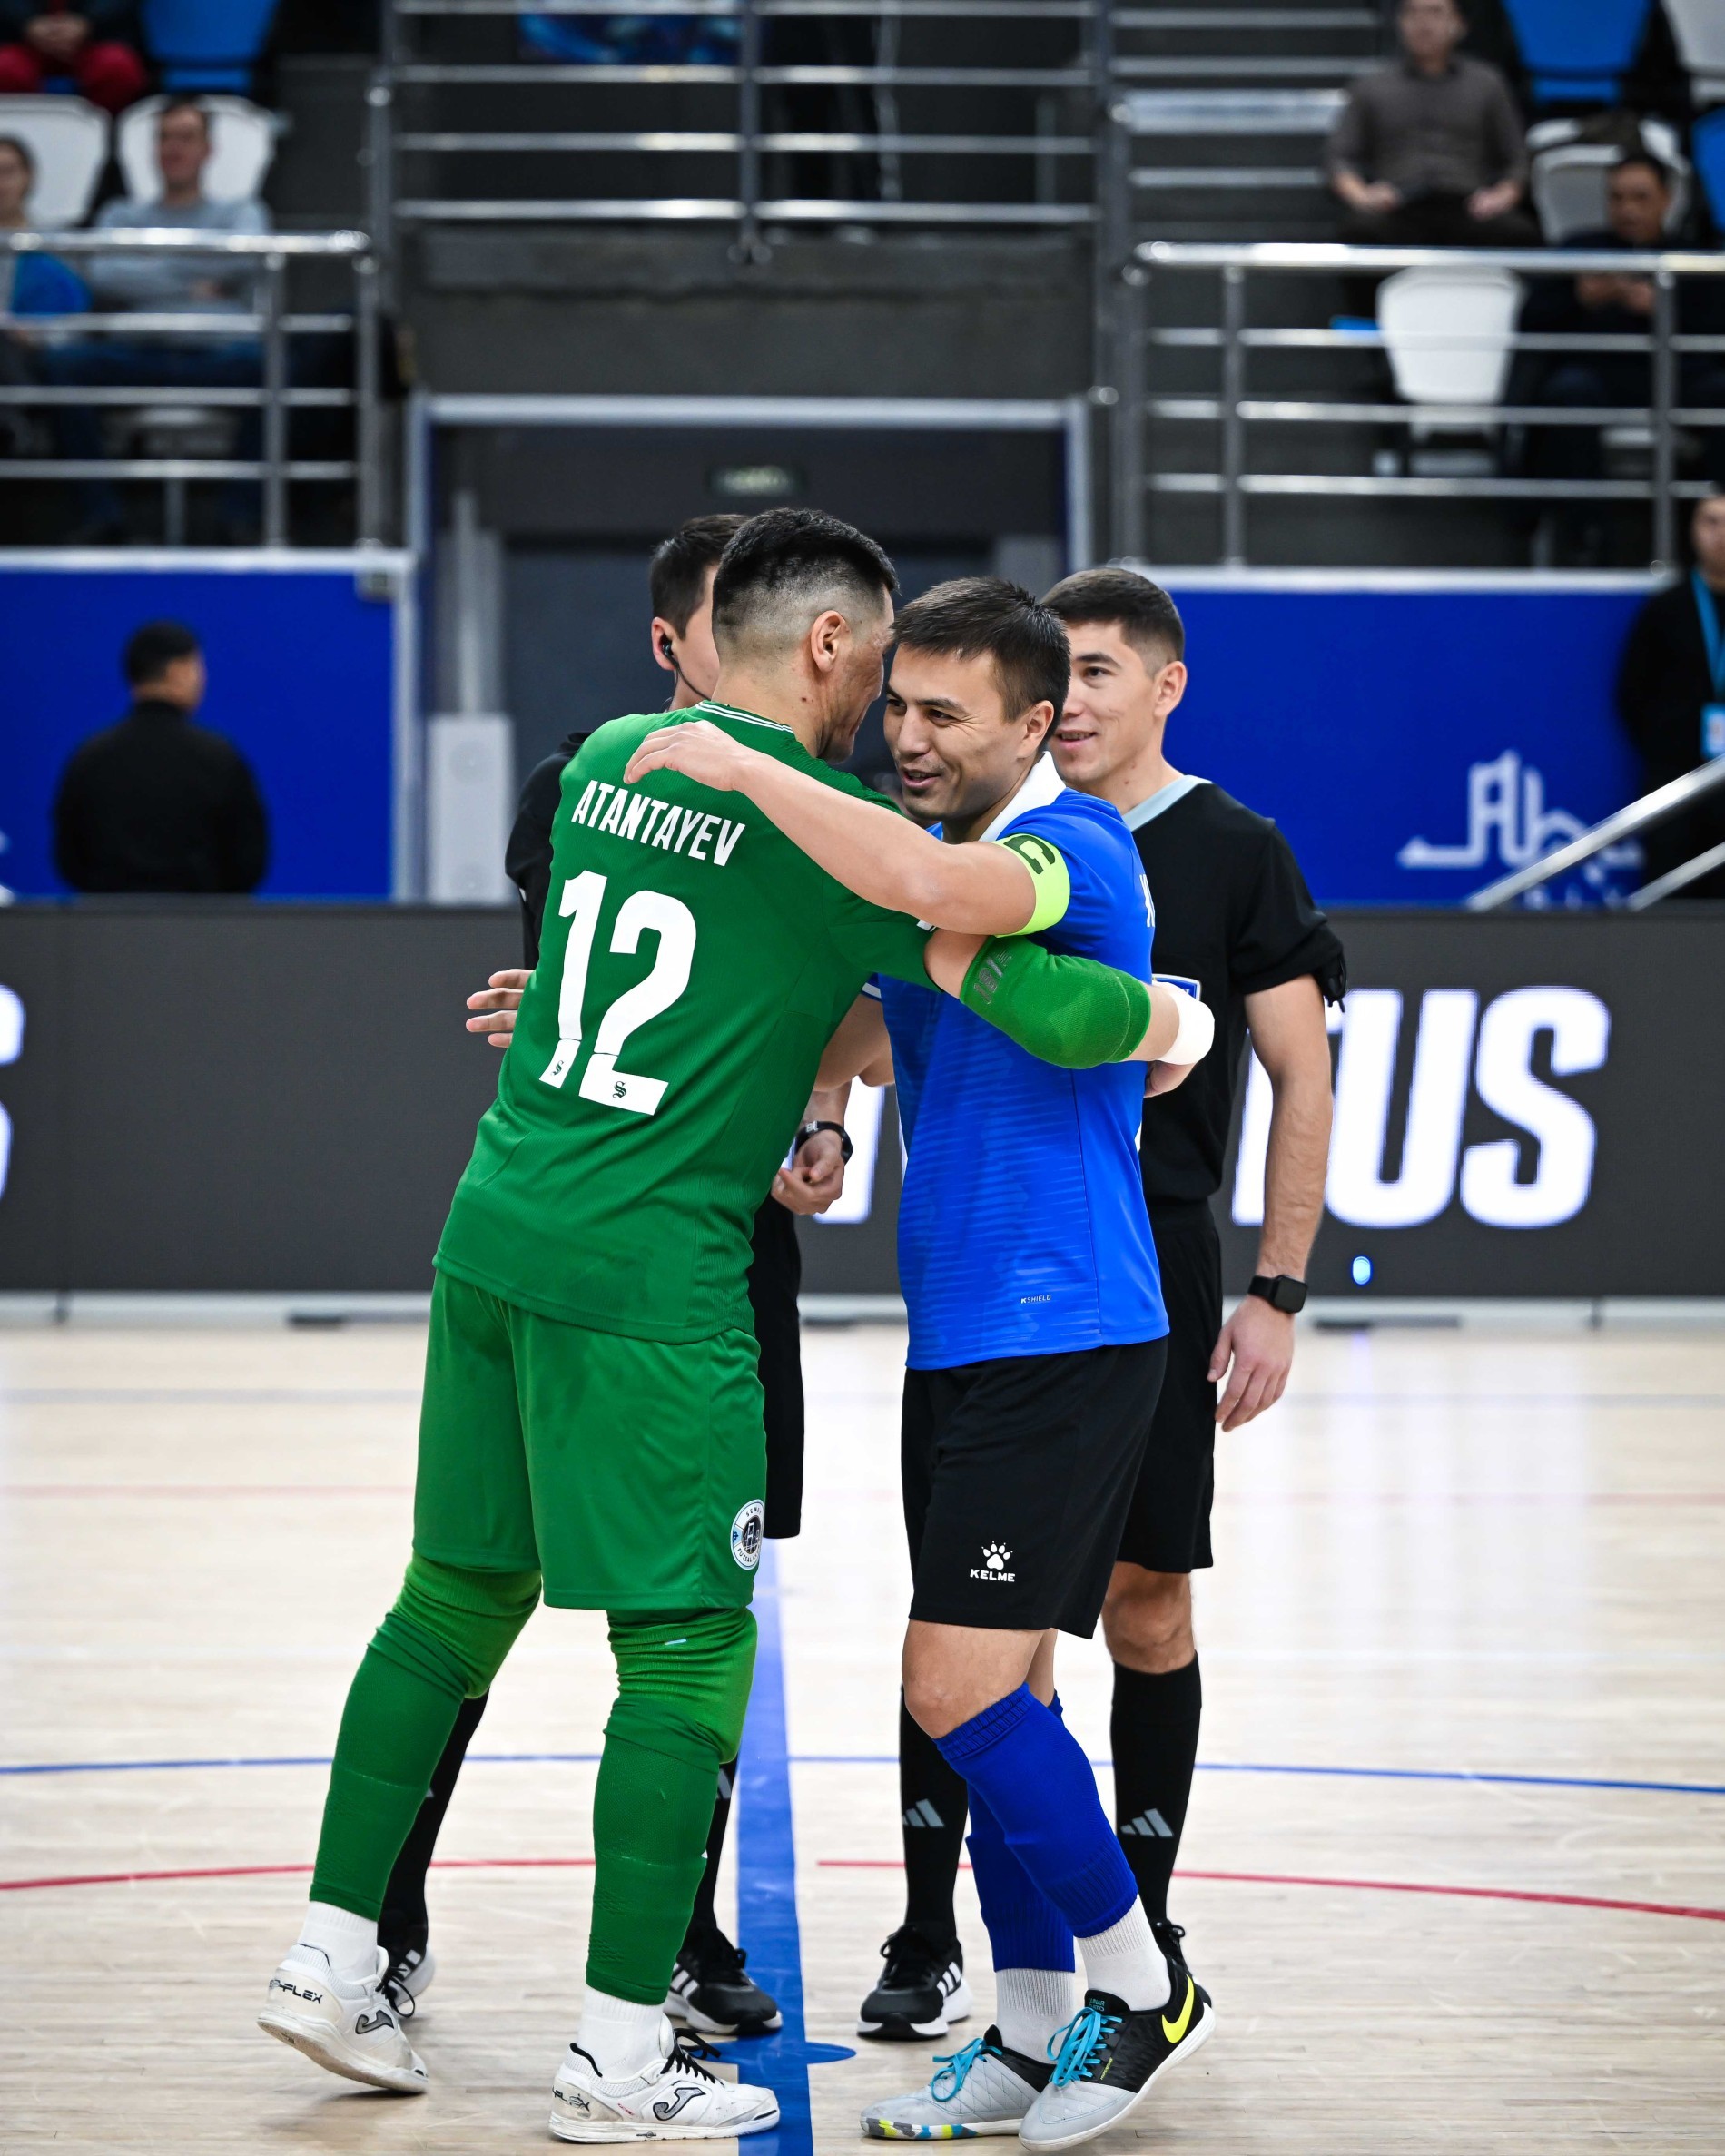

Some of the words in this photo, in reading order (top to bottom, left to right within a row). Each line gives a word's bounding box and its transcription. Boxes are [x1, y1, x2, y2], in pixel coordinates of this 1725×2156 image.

[571, 779, 746, 867] ATANTAYEV
[1003, 835, 1056, 875] C
[538, 869, 697, 1116] 12
[970, 1568, 1016, 1582] KELME
